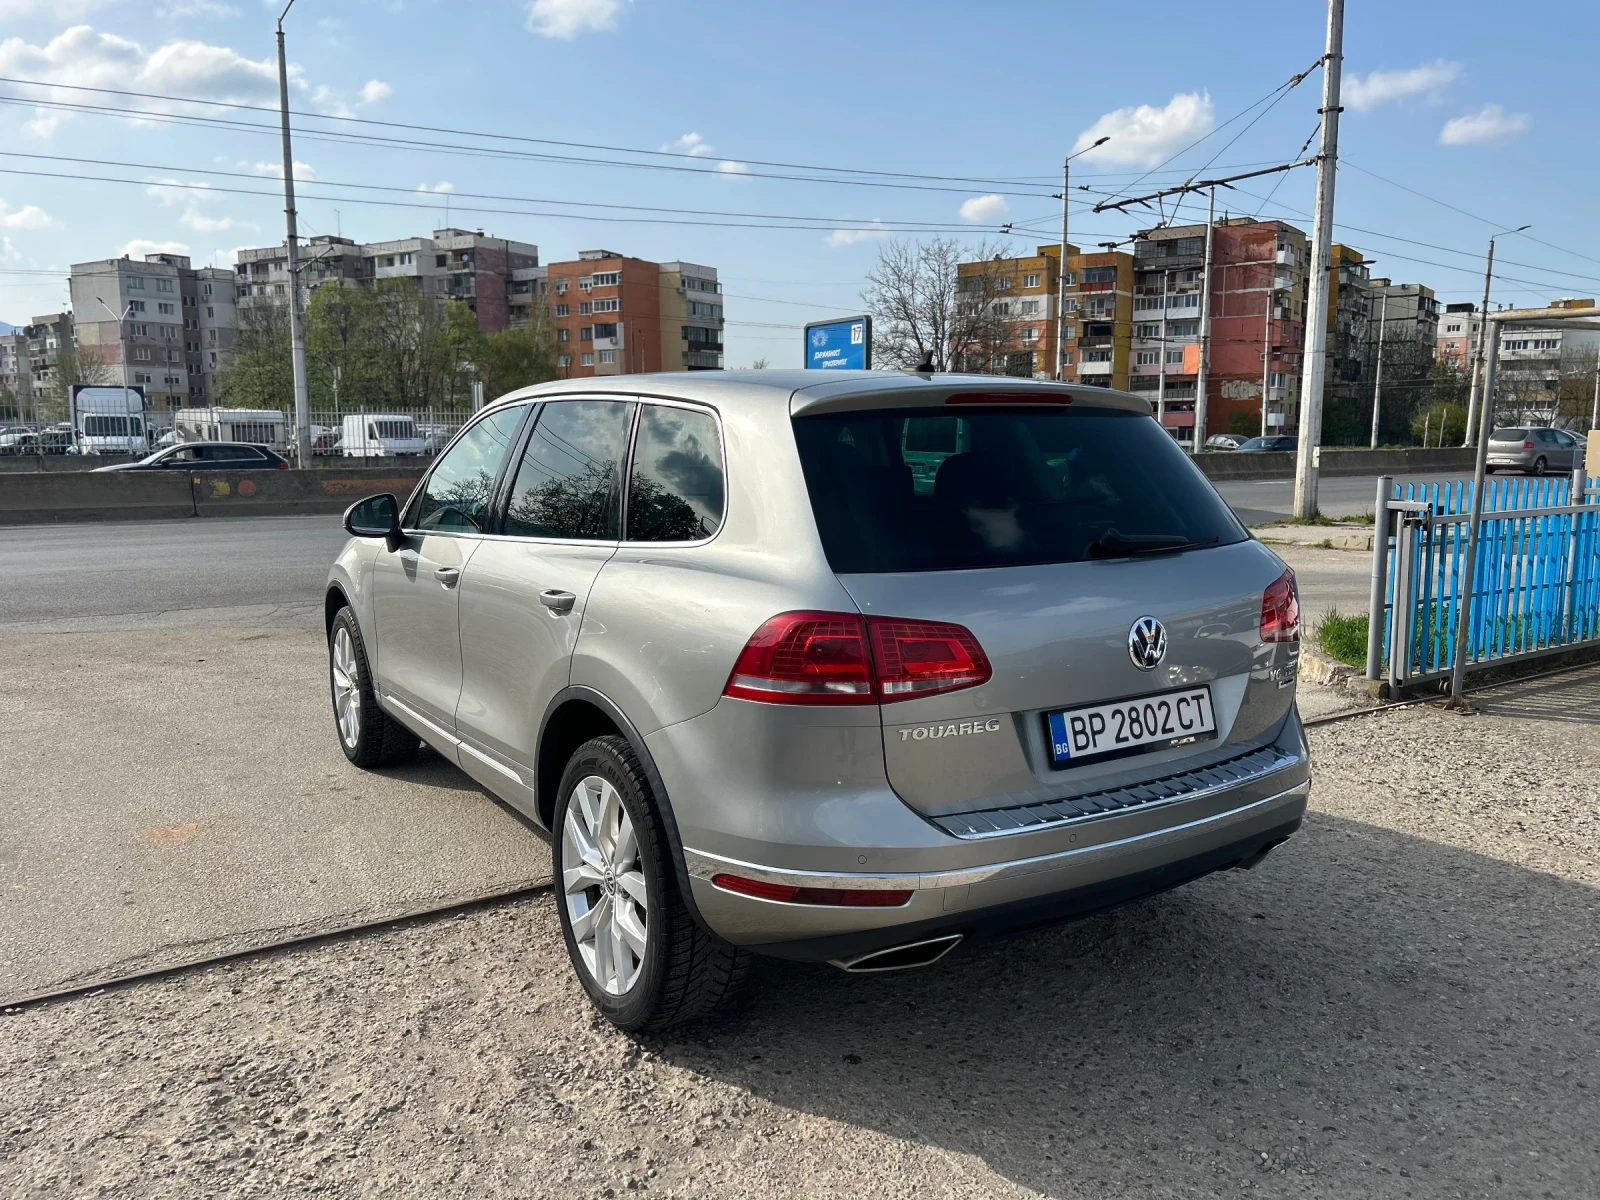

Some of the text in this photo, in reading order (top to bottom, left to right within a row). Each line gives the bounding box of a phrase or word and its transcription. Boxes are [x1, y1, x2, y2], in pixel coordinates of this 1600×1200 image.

[852, 327, 861, 342] 17
[1269, 668, 1281, 681] V6
[898, 718, 1000, 741] TOUAREG
[1070, 694, 1205, 752] BP 2802 CT
[1055, 742, 1069, 755] BG
